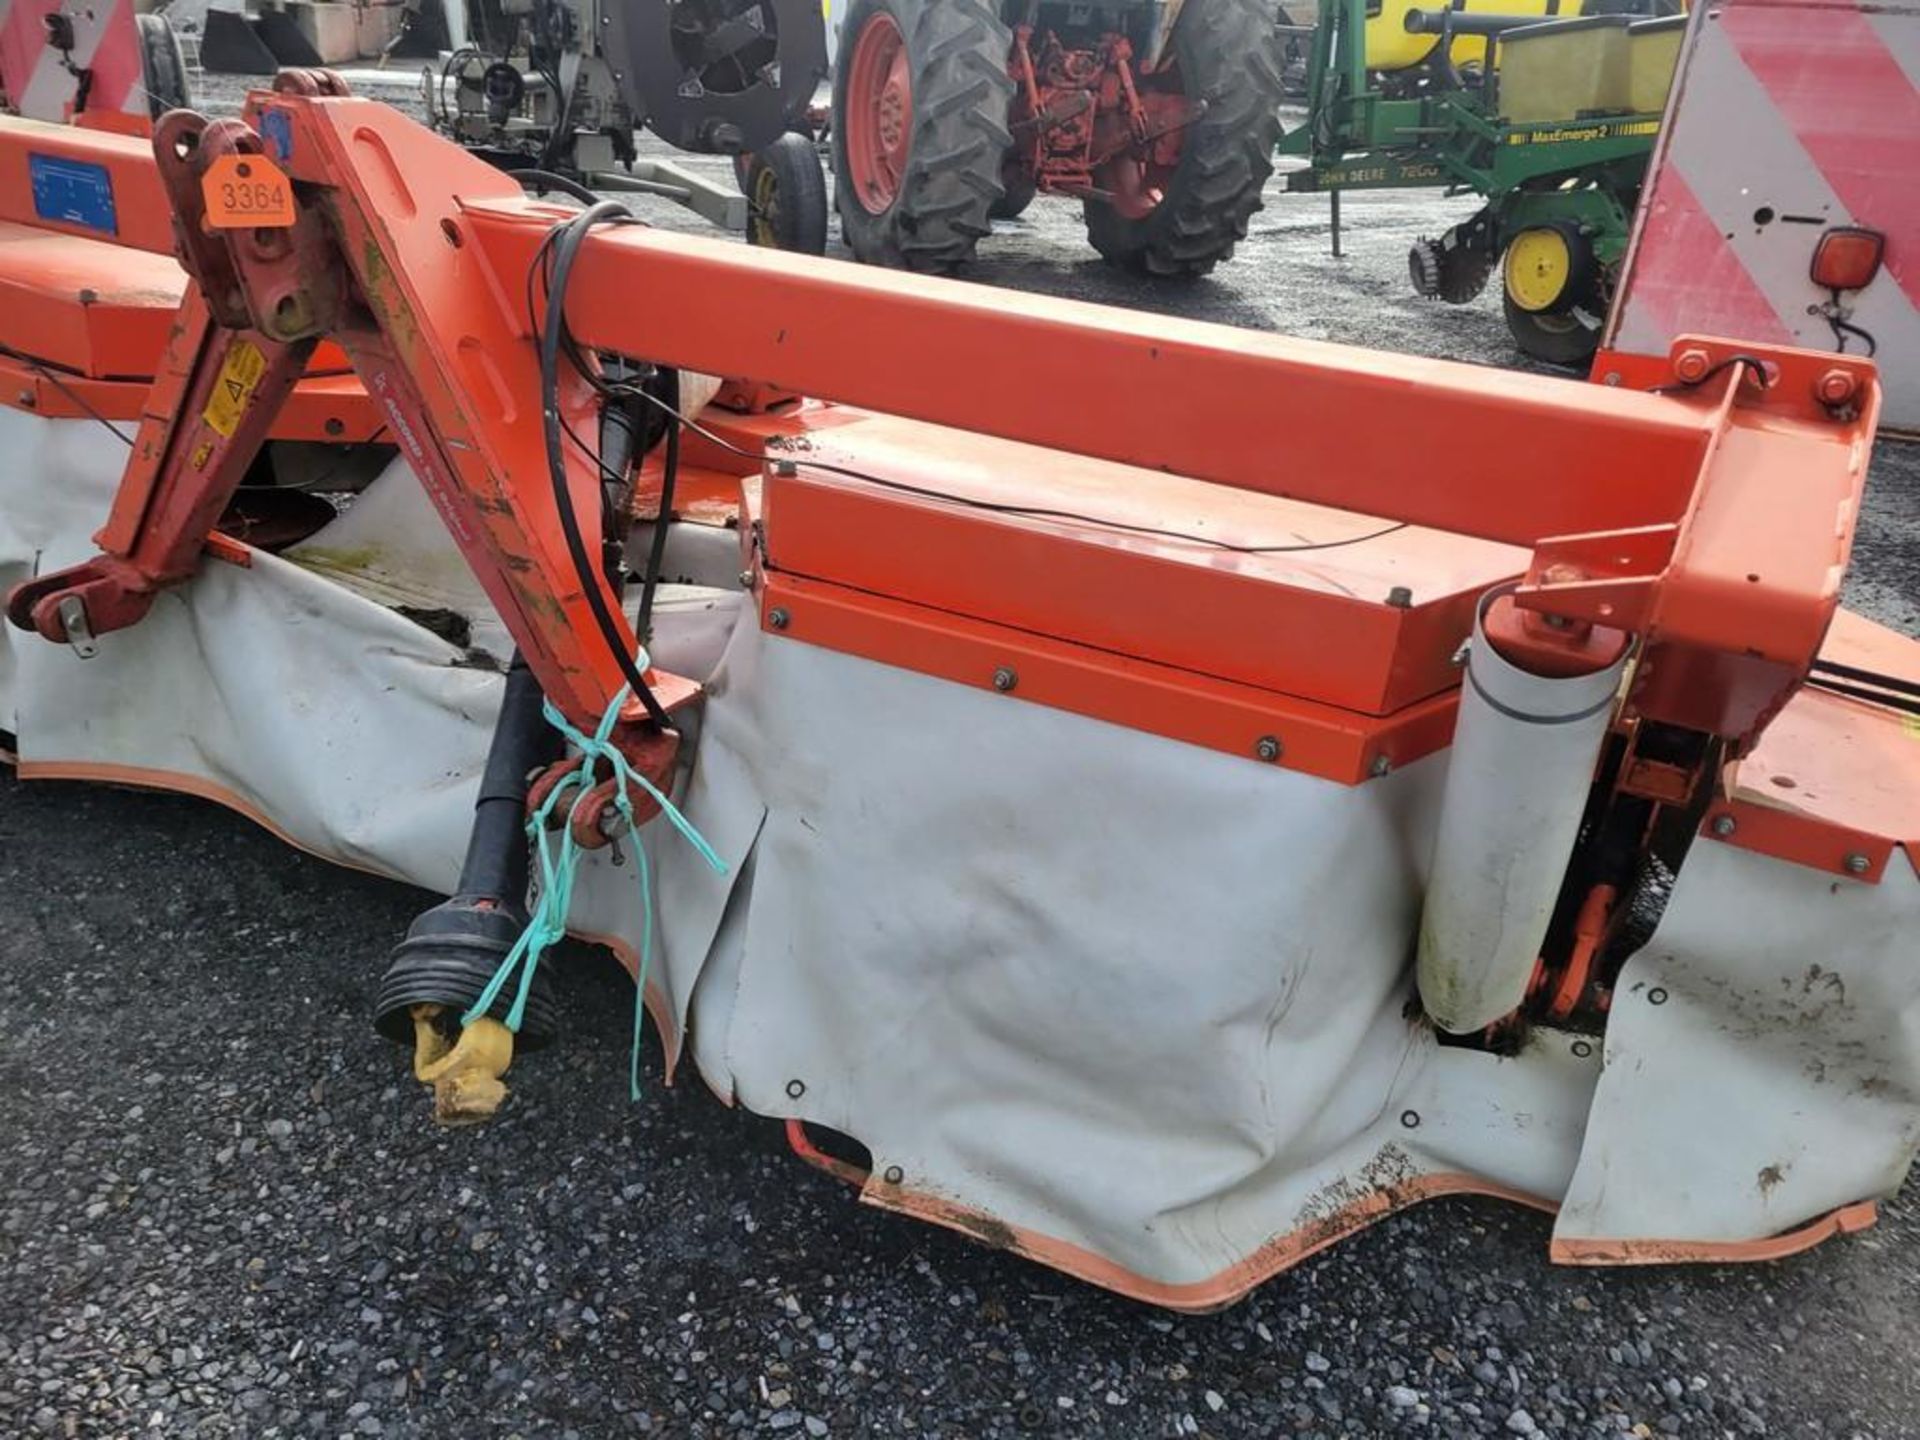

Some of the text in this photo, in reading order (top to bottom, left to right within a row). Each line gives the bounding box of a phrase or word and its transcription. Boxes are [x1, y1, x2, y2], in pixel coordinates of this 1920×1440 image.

[1531, 124, 1608, 143] MaxEmerge 2
[222, 182, 285, 210] 3364
